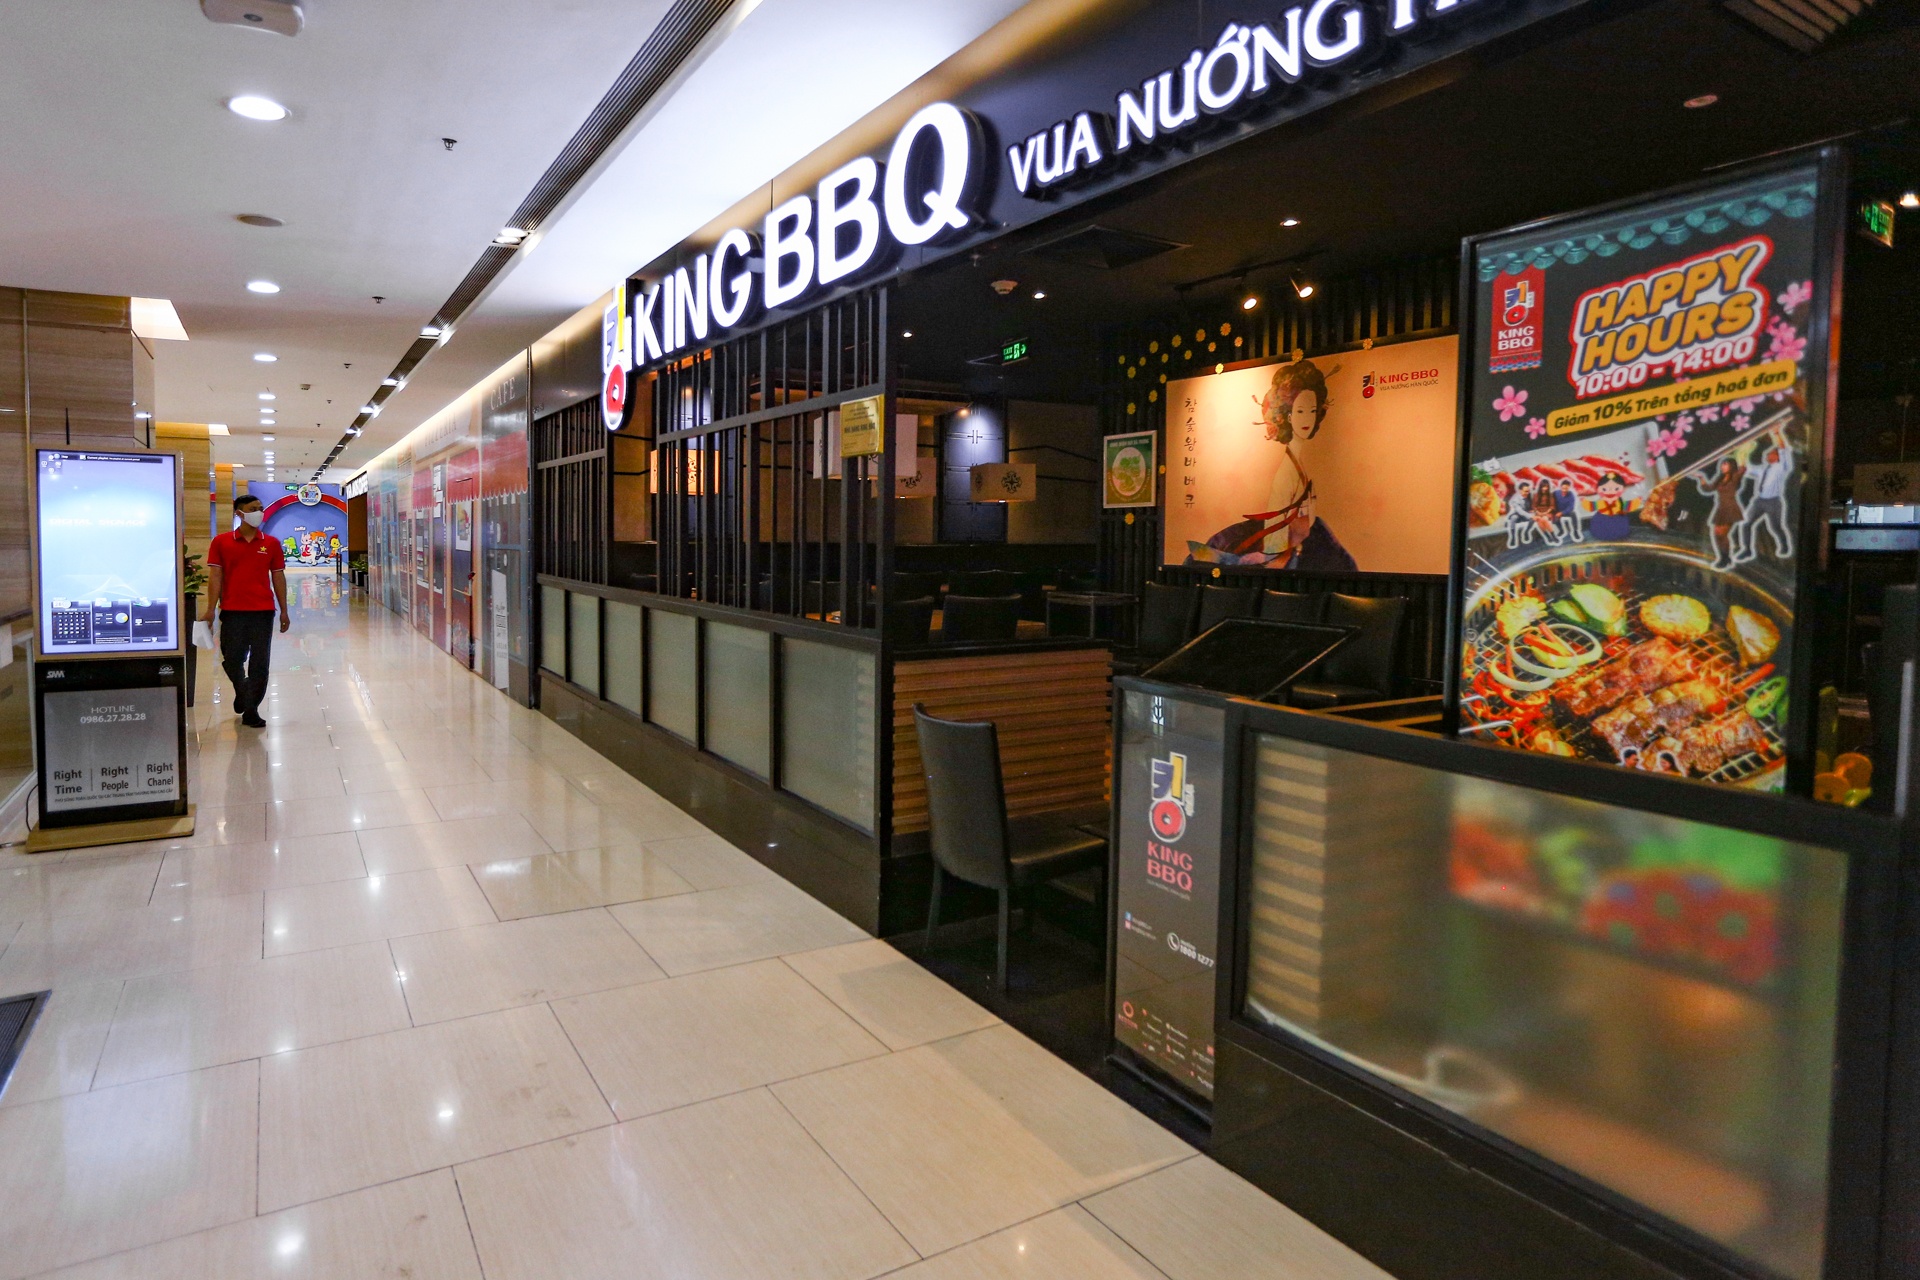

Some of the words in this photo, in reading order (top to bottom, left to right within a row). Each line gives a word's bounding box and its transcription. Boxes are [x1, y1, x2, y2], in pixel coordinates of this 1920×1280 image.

[1008, 112, 1100, 193] VUA
[1117, 0, 1363, 149] NƯỚNG
[634, 227, 752, 367] KING
[764, 101, 970, 309] BBQ
[1581, 244, 1759, 336] HAPPY
[1498, 326, 1534, 340] KING
[1579, 291, 1757, 374] HOURS
[1498, 336, 1534, 350] BBQ
[1576, 363, 1648, 396] 10:00
[1672, 336, 1755, 376] 14:00
[1380, 372, 1408, 384] KING
[1411, 368, 1438, 380] BBQ
[490, 377, 516, 411] CAFE
[1554, 410, 1590, 429] Giảm
[1593, 400, 1632, 420] 10%
[1636, 396, 1668, 412] Trên
[1674, 385, 1710, 404] tổng
[1716, 375, 1748, 395] hoá
[1753, 368, 1788, 386] đơn
[91, 704, 136, 714] HOTLINE
[80, 712, 146, 724] 0986.27.28.28
[54, 770, 82, 782] Right
[101, 766, 128, 778] Right
[146, 763, 173, 774] Right
[101, 780, 128, 792] People
[148, 776, 174, 787] Chanel
[55, 785, 82, 794] Time
[1148, 840, 1193, 872] KING
[1147, 858, 1192, 892] BBQ
